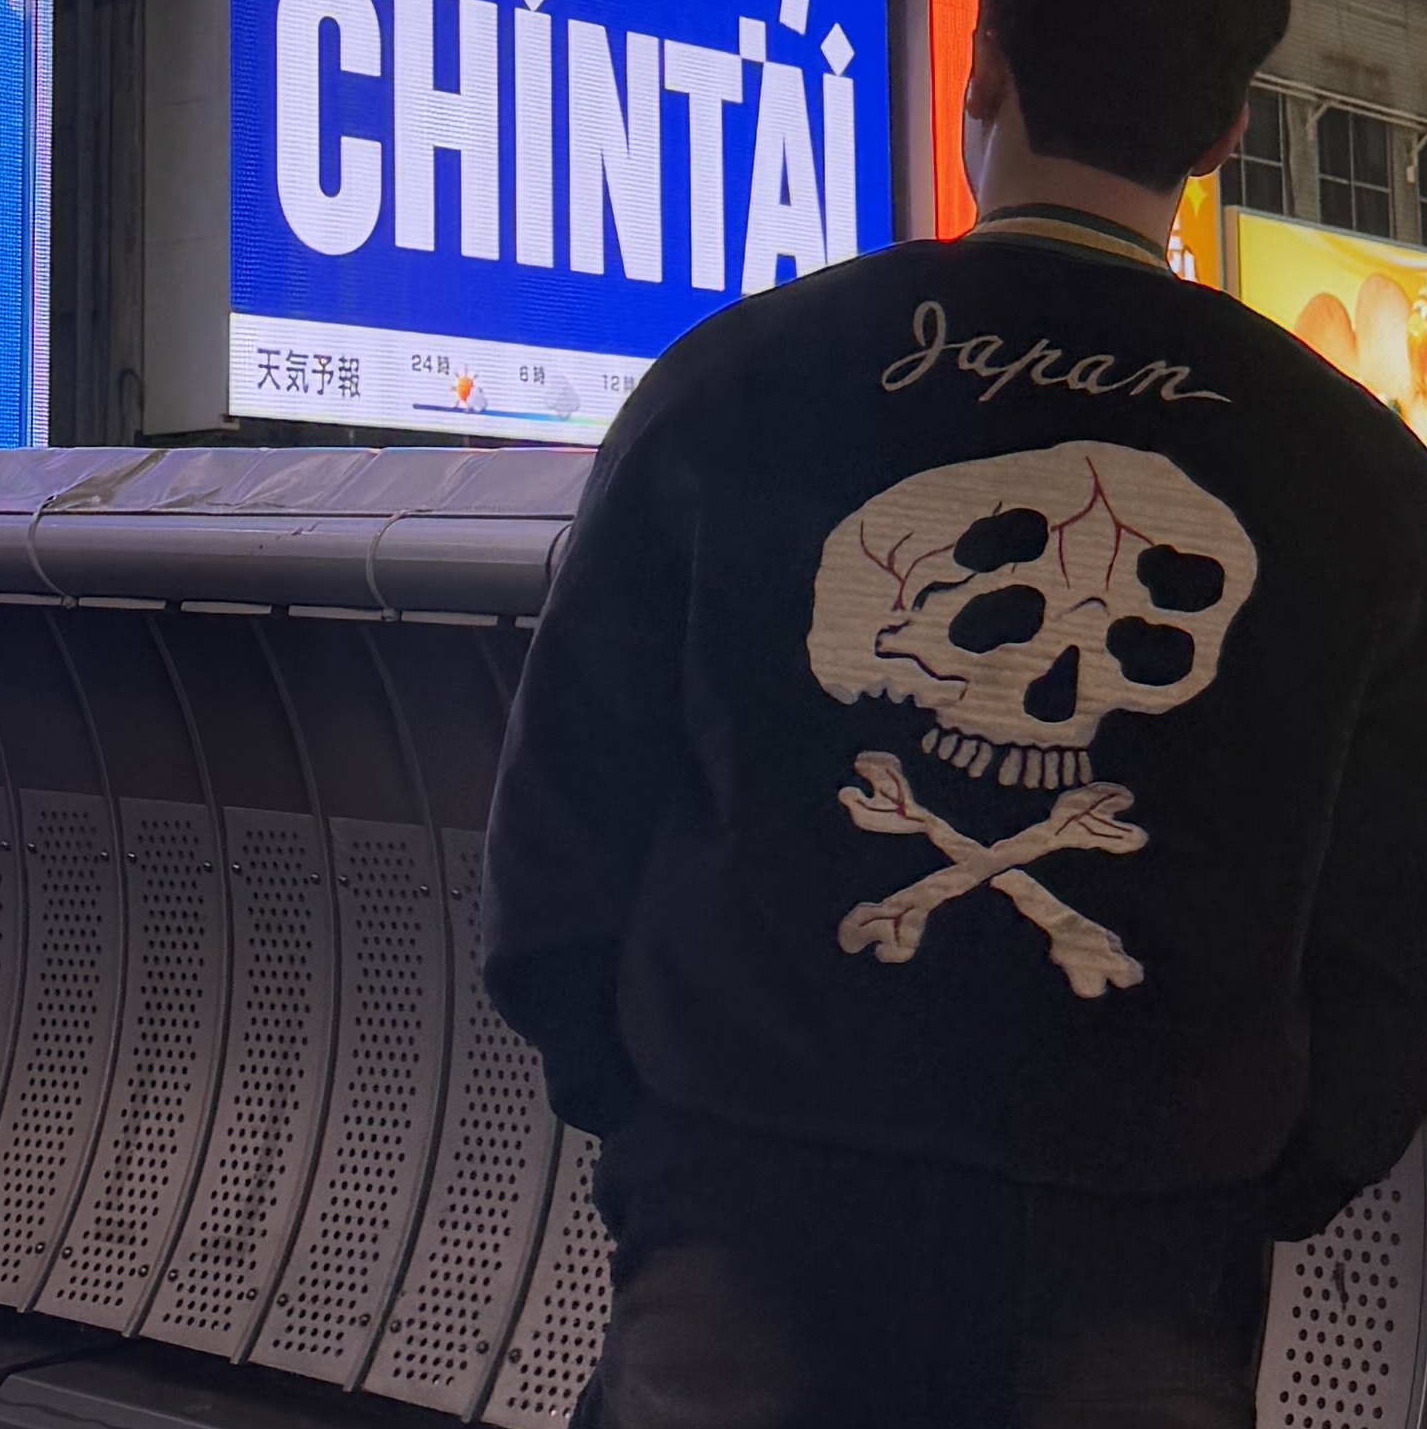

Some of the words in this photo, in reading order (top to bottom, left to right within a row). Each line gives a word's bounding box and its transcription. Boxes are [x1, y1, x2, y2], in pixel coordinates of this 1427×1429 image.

[257, 346, 361, 399] 天気予報
[880, 300, 1232, 404] Japan
